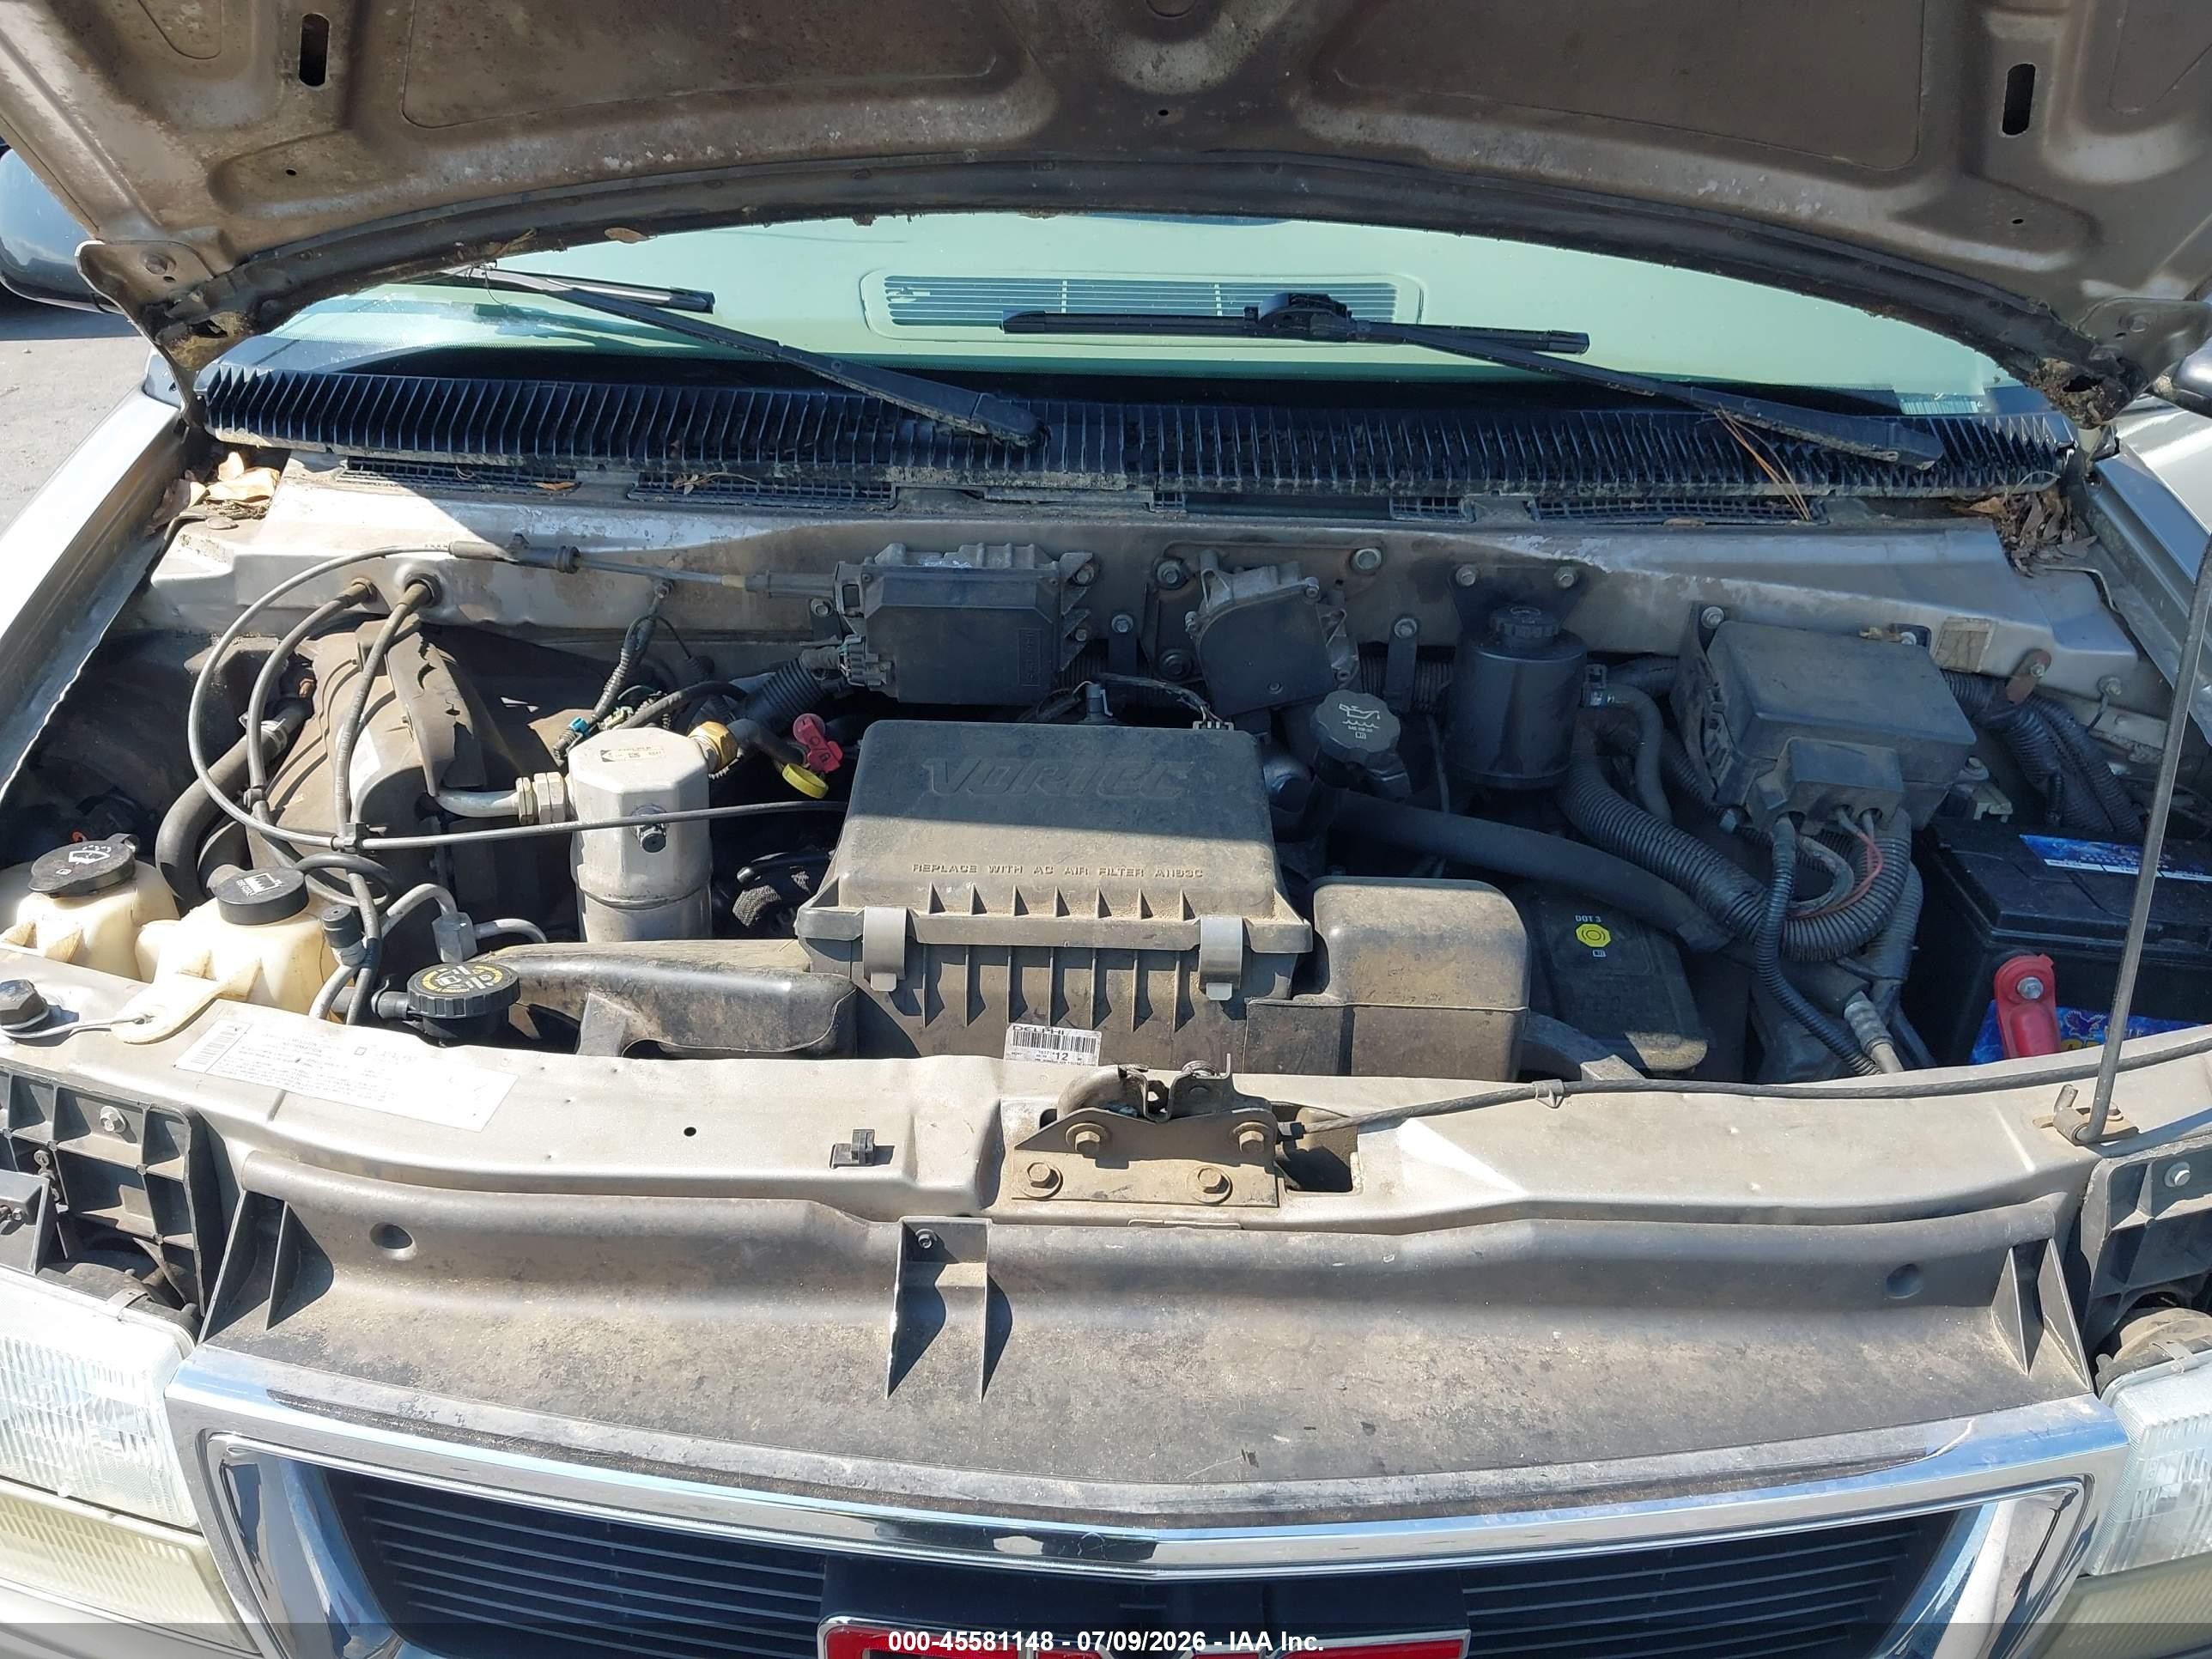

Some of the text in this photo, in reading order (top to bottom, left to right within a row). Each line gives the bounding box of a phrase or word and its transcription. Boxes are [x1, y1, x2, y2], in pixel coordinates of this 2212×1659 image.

[912, 864, 977, 873] REPLACE
[988, 865, 1024, 874] WITH
[1033, 866, 1054, 875] AC
[1064, 866, 1089, 876] AIR
[1098, 867, 1145, 878] FILTER
[1012, 1025, 1065, 1035] DELPHI
